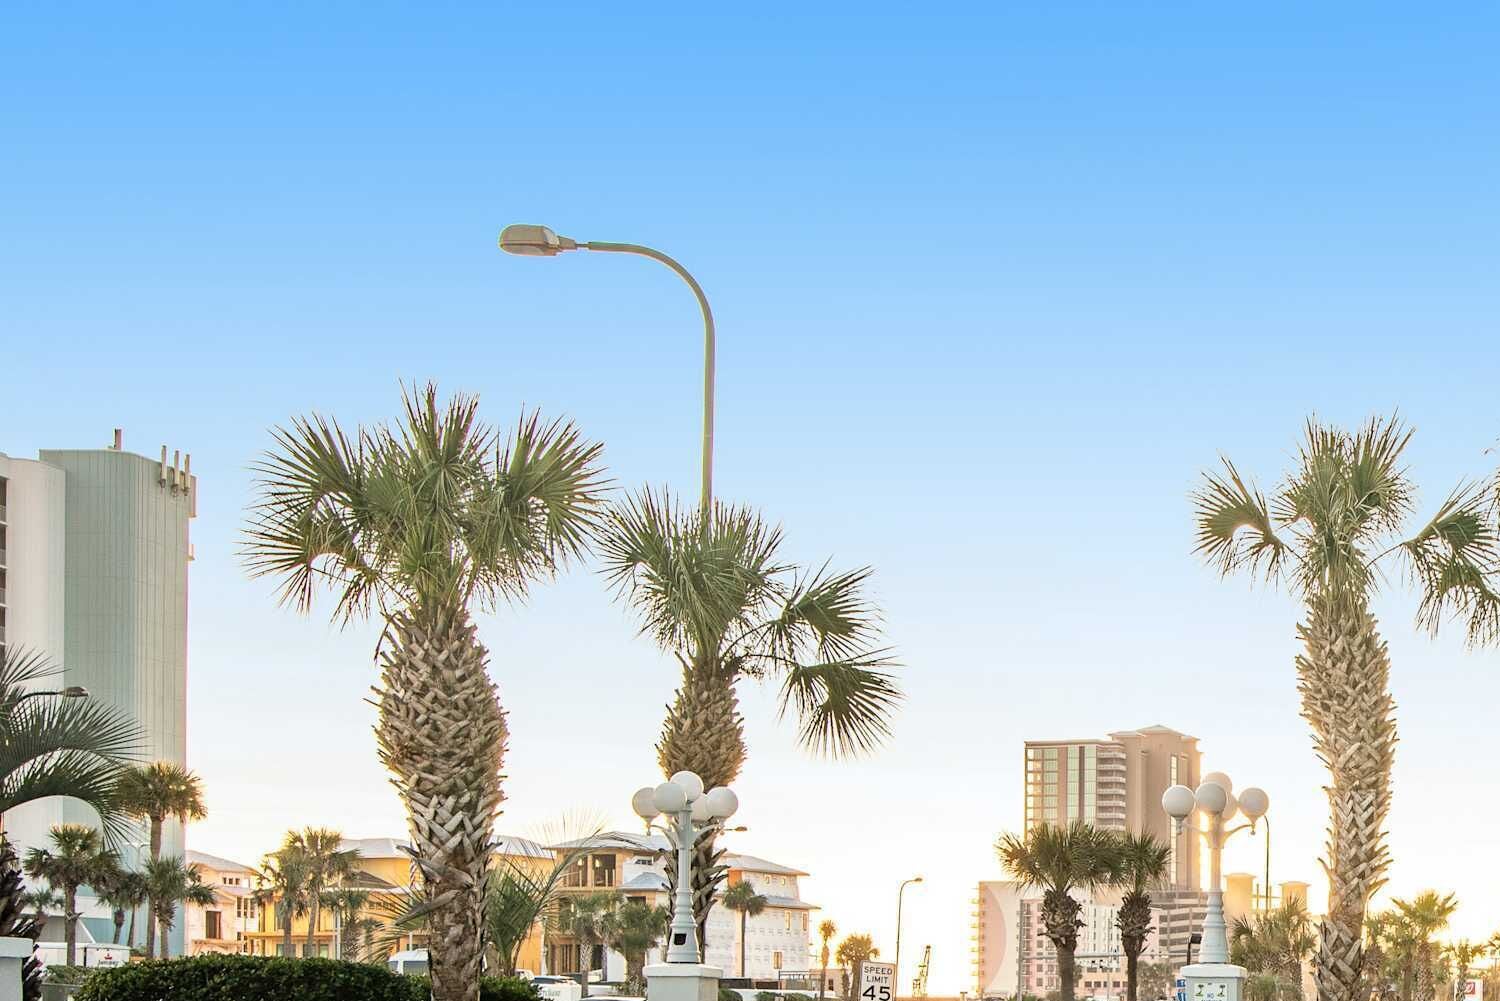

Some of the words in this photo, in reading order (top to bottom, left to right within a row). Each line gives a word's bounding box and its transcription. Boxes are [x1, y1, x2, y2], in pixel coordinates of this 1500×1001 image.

[864, 966, 893, 975] SPEED
[866, 976, 889, 984] LIMIT
[862, 985, 891, 1001] 45
